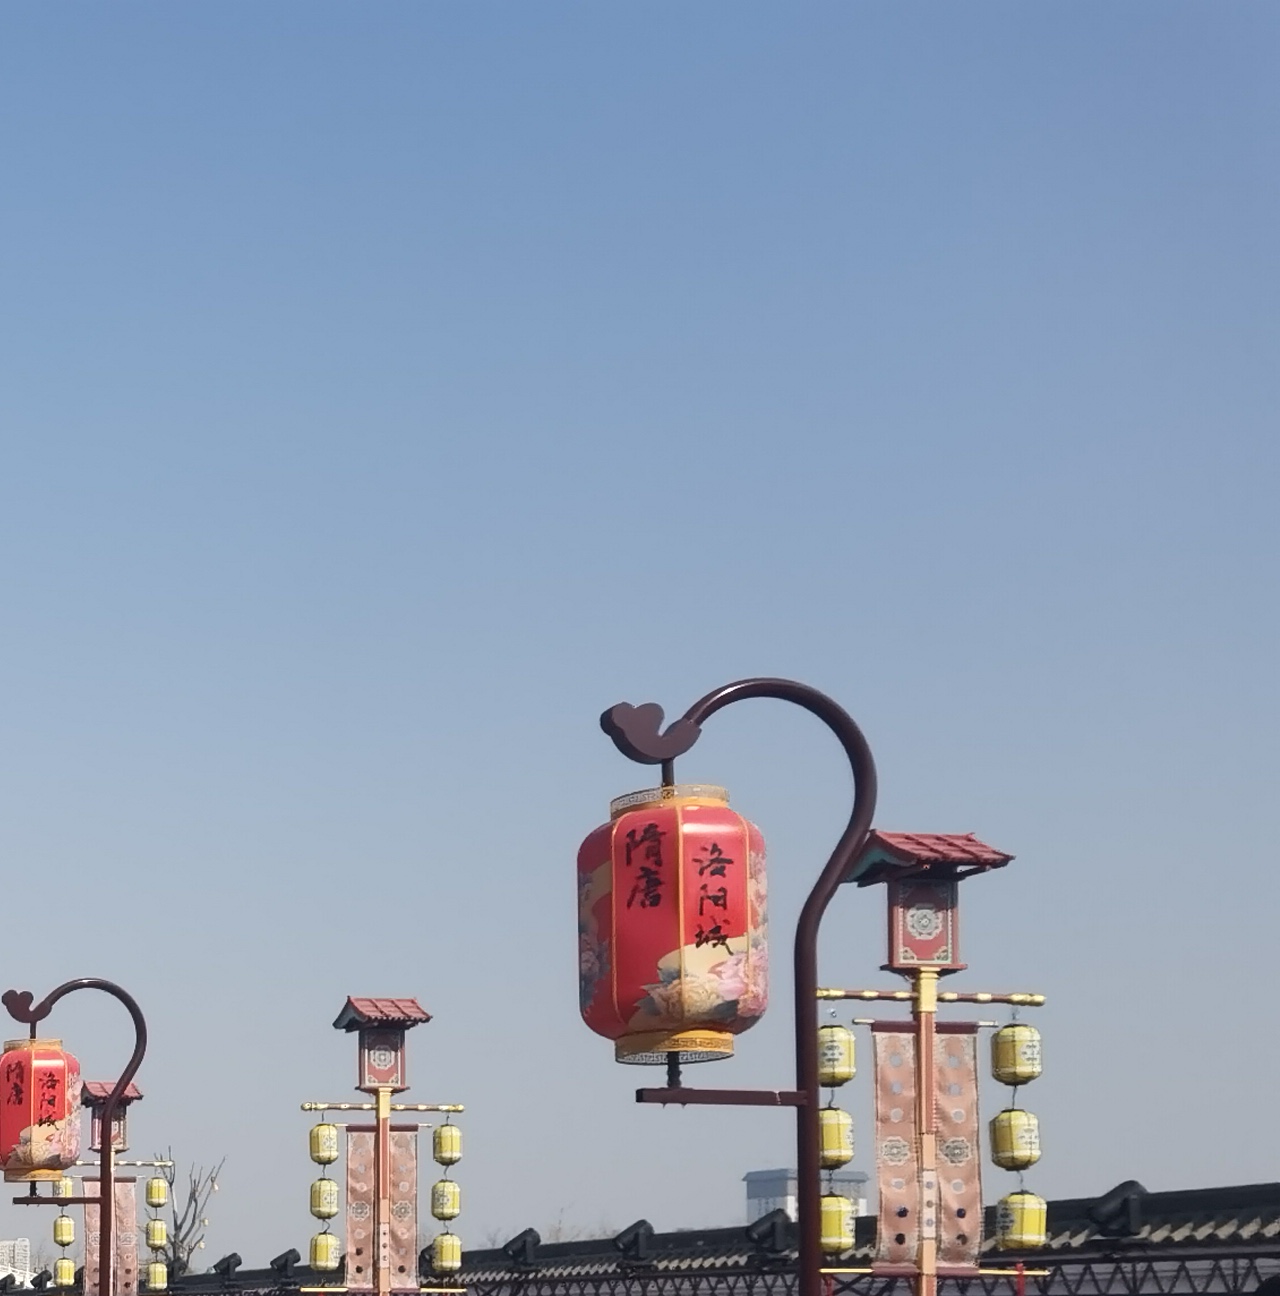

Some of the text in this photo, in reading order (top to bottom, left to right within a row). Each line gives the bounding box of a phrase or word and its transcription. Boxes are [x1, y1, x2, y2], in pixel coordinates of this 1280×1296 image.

[625, 822, 666, 910] 隋唐
[692, 843, 734, 956] 洛阳城
[38, 1071, 60, 1131] 洛阳城
